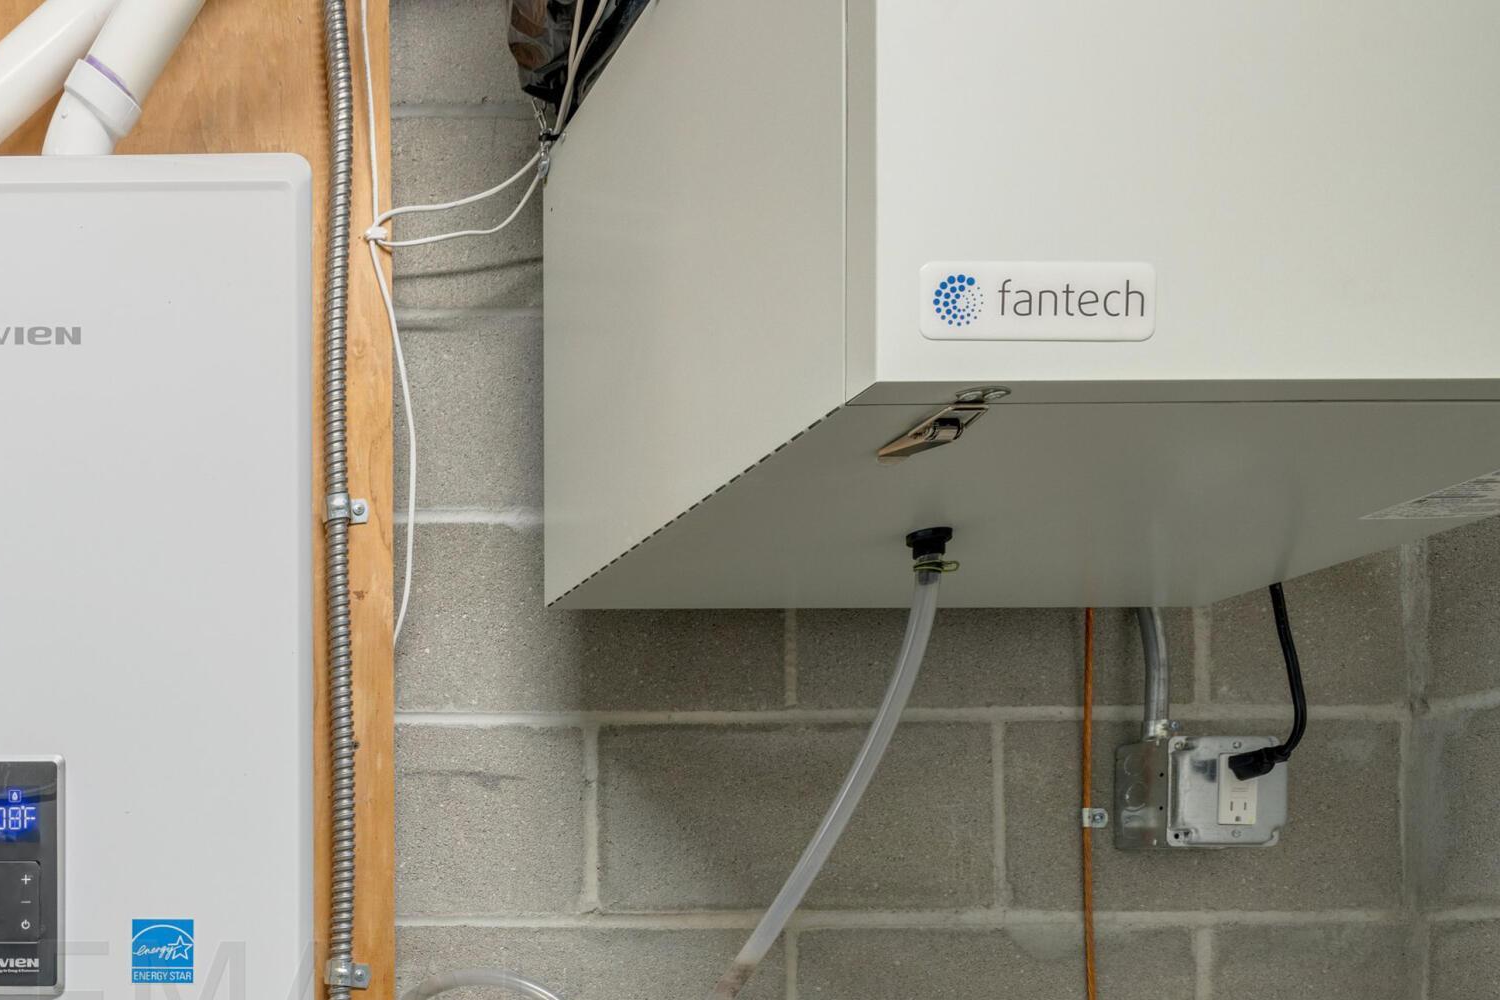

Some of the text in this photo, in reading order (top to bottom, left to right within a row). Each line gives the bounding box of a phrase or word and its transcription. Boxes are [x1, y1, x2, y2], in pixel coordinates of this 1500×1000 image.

[997, 279, 1146, 317] fantech
[133, 971, 192, 981] ENERGY STAR
